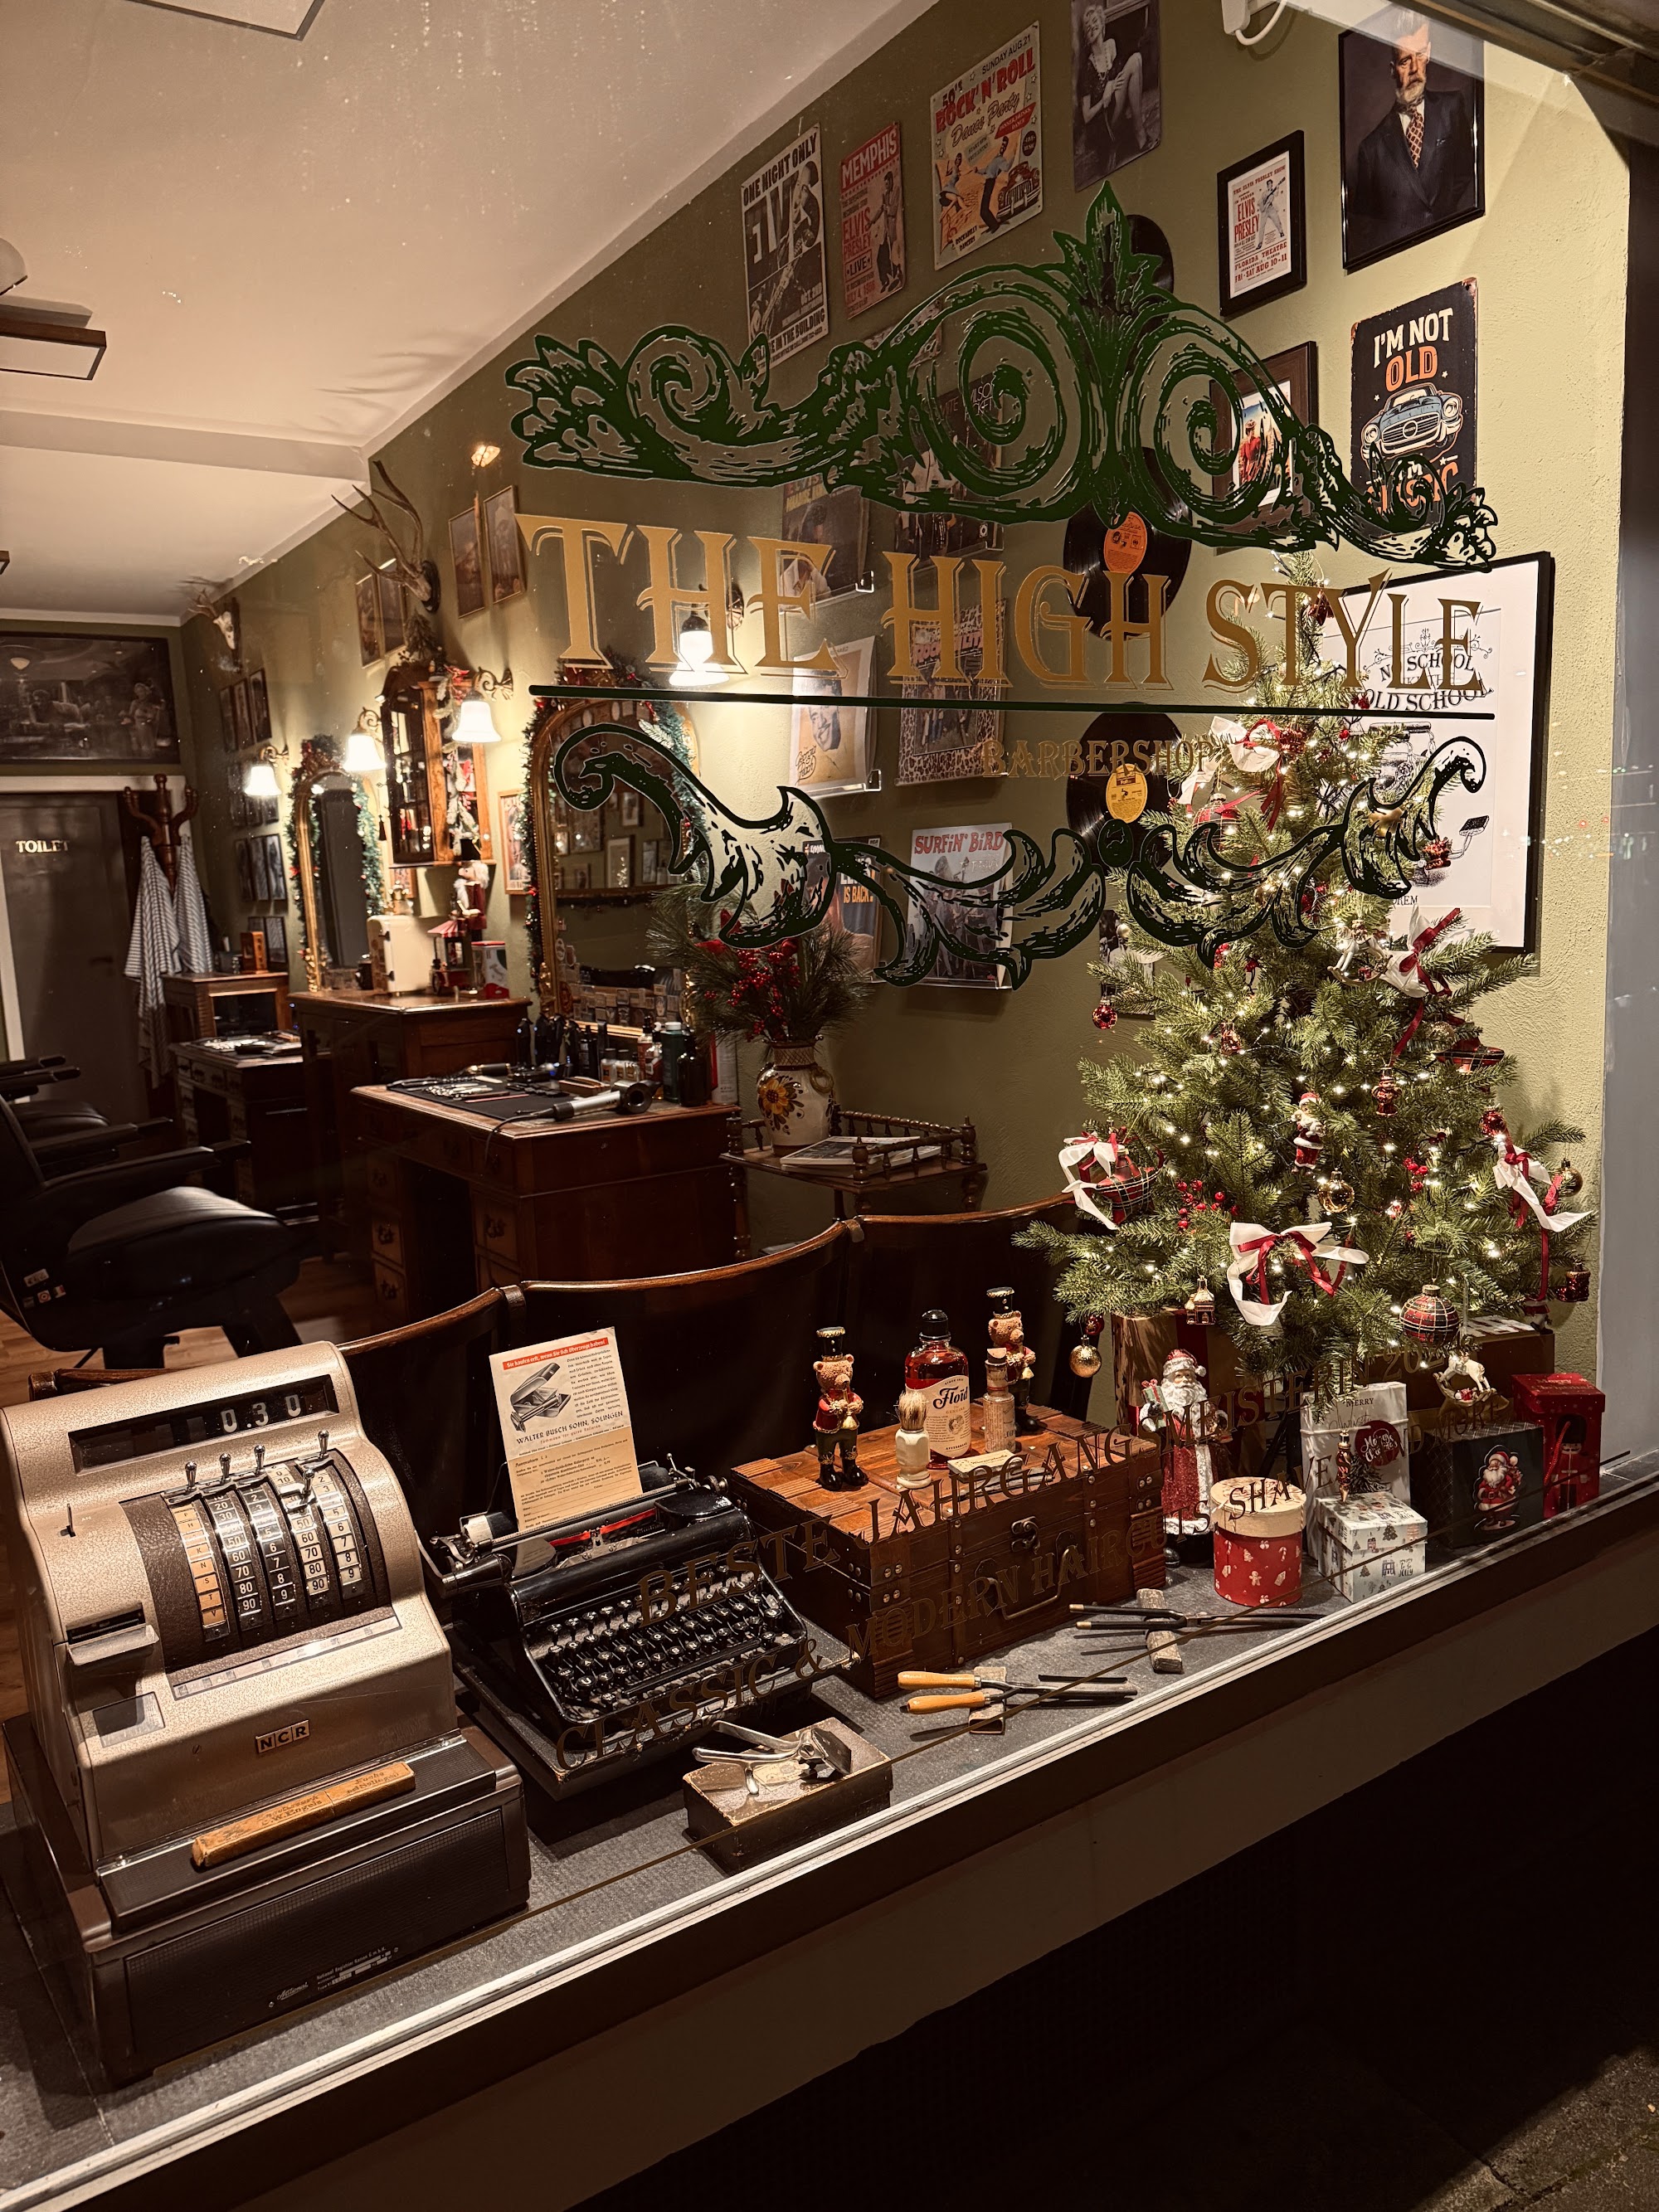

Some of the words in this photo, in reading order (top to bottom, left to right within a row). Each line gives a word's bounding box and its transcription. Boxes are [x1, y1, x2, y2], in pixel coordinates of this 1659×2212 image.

[982, 51, 1007, 75] SUNDAY
[951, 116, 985, 148] Dance
[987, 91, 1019, 126] Party
[842, 129, 897, 189] MEMPHIS
[743, 177, 761, 206] ONE
[761, 153, 791, 193] NIGHT
[792, 132, 816, 168] ONLY
[1238, 197, 1255, 222] ELVIS
[843, 207, 871, 244] ELVIS
[1234, 213, 1259, 243] PRESLEY
[1234, 255, 1258, 270] FLORIDA
[1262, 241, 1287, 258] THEATRE
[849, 256, 867, 276] LIVE
[1246, 268, 1254, 278] SAT
[1256, 262, 1269, 274] AUG
[1374, 323, 1404, 368] I'M
[1409, 308, 1453, 347] NOT
[1385, 346, 1438, 392] OLD
[514, 513, 848, 679] THE
[881, 552, 1171, 693] HIGH
[1203, 567, 1484, 693] STYLE
[981, 739, 1214, 780] BARBERSHOP
[15, 839, 70, 853] TOILET
[843, 886, 850, 904] IS
[932, 1386, 968, 1409] Floïd
[1346, 1398, 1374, 1407] MERRY
[516, 1432, 544, 1445] WALTER
[546, 1426, 567, 1437] BUSCH
[569, 1420, 590, 1430] SOHN,
[591, 1411, 623, 1425] SOLINGEN
[946, 1442, 967, 1451] AFTERSHAVE
[638, 1514, 840, 1629] BESTE
[855, 1354, 1370, 1546] JAHRGANGSMEISTERIN
[222, 1512, 232, 1521] 30
[296, 1519, 309, 1529] 50
[338, 1523, 344, 1531] 6
[301, 1532, 314, 1543] 60
[341, 1537, 347, 1548] 7
[270, 1543, 277, 1552] 6
[305, 1548, 318, 1558] 70
[231, 1551, 246, 1562] 60
[274, 1557, 280, 1568] 7
[345, 1553, 351, 1562] 8
[236, 1567, 249, 1578] 70
[309, 1563, 321, 1574] 80
[348, 1568, 354, 1578] 9
[278, 1573, 285, 1583] 8
[312, 1578, 324, 1590] 90
[239, 1582, 253, 1593] 80
[281, 1589, 288, 1600] 9
[242, 1597, 256, 1610] 90
[557, 1655, 778, 1771] CLASSIC
[794, 1639, 826, 1680] &
[845, 1553, 1019, 1665] MODERN
[1229, 1453, 1352, 1521] SHAVES
[260, 1724, 308, 1752] NCR
[276, 1981, 309, 2001] National
